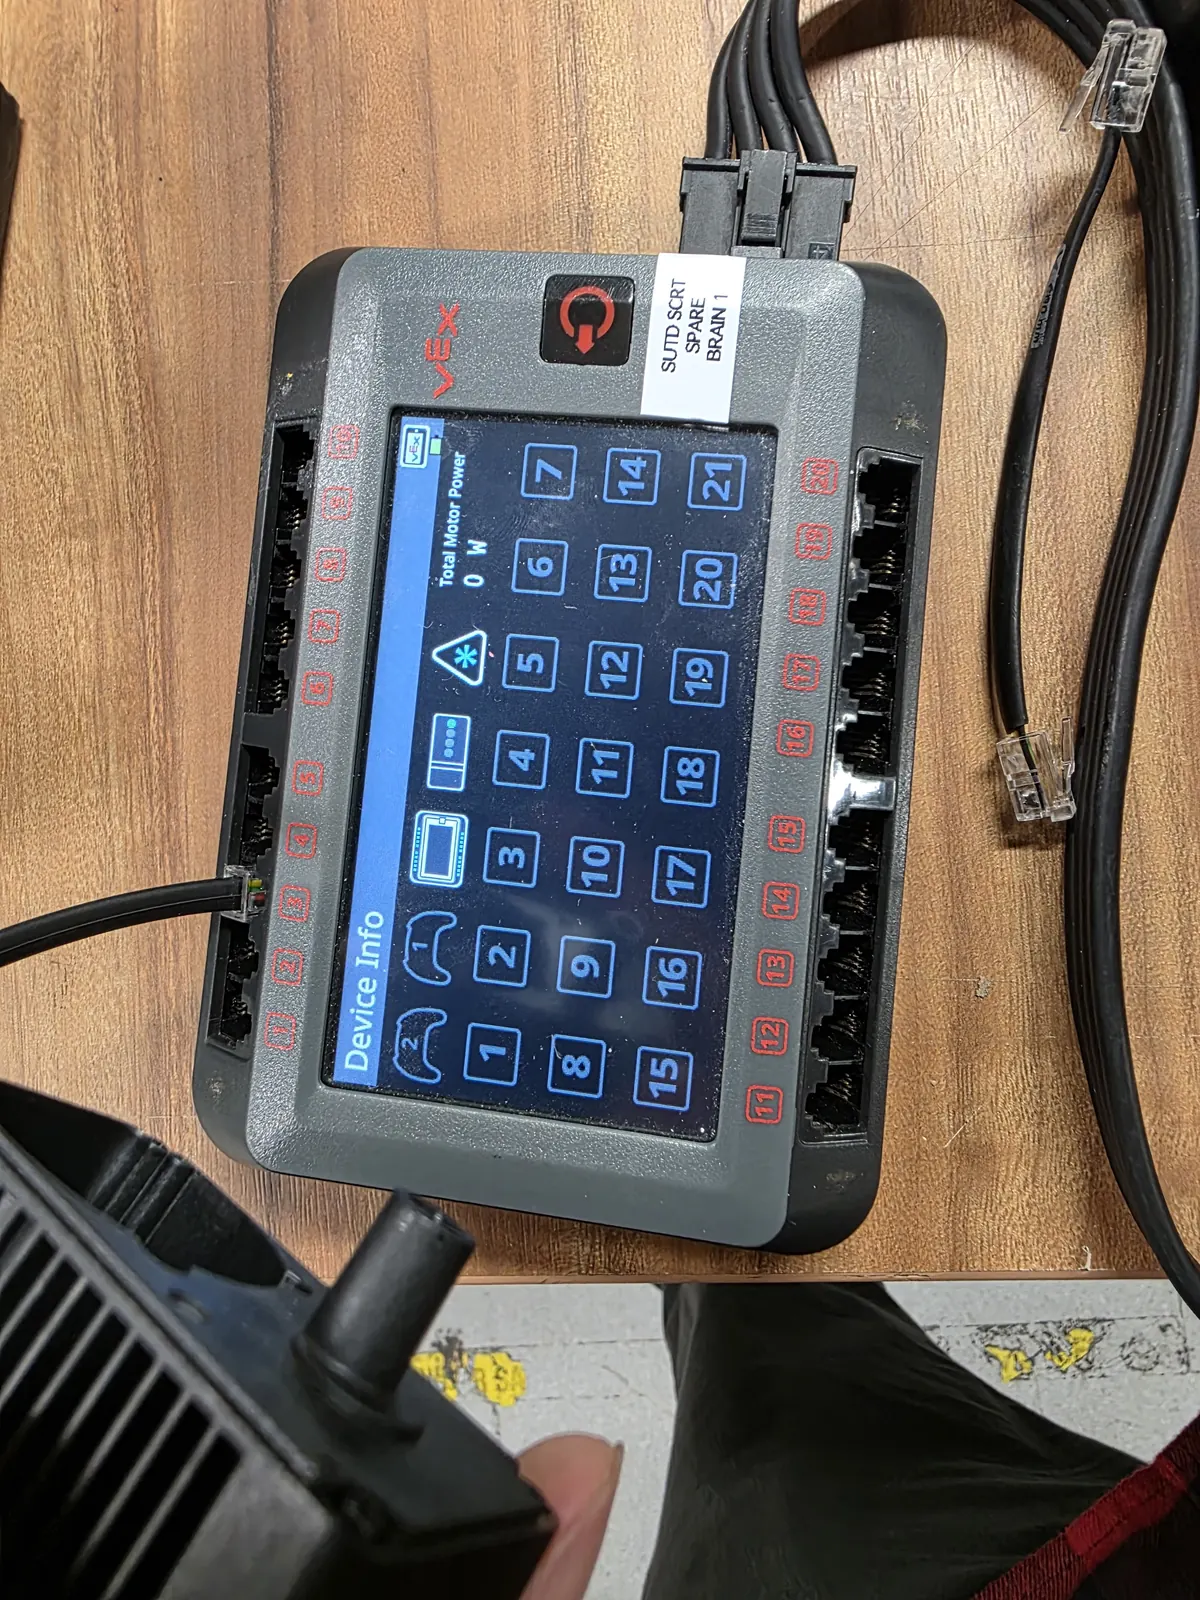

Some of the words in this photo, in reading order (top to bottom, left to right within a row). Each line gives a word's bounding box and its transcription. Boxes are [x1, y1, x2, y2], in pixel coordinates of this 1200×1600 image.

[667, 279, 685, 320] SCRT
[686, 297, 706, 354] SPARE
[707, 308, 726, 361] BRAIN
[661, 325, 679, 372] SUTD
[448, 451, 465, 498] Power
[535, 459, 562, 482] 7
[618, 457, 646, 496] 14
[703, 462, 732, 501] 21
[811, 463, 830, 489] 20
[444, 502, 460, 547] Motor
[467, 540, 487, 555] W
[805, 528, 823, 554] 19
[439, 551, 455, 587] Total
[528, 557, 553, 577] 6
[609, 554, 637, 592] 13
[693, 558, 722, 601] 20
[463, 574, 484, 587] 0
[798, 594, 817, 620] 18
[517, 654, 544, 673] 5
[600, 652, 628, 689] 12
[792, 660, 810, 684] 17
[685, 658, 713, 696] 19
[786, 726, 805, 750] 16
[509, 749, 535, 771] 4
[592, 750, 619, 784] 11
[300, 772, 315, 784] 5
[676, 758, 704, 794] 18
[294, 835, 309, 846] 4
[778, 822, 796, 846] 15
[499, 847, 525, 868] 3
[581, 845, 609, 887] 10
[666, 856, 695, 895] 17
[287, 897, 302, 909] 3
[772, 888, 791, 913] 14
[356, 912, 384, 969] Info
[412, 942, 427, 951] 1
[280, 960, 295, 973] 2
[489, 946, 515, 968] 2
[571, 955, 599, 977] 9
[766, 956, 785, 980] 13
[658, 958, 687, 996] 16
[273, 1025, 289, 1036] 1
[345, 978, 377, 1071] Device
[761, 1023, 780, 1048] 12
[402, 1038, 418, 1050] 2
[479, 1043, 506, 1062] 1
[562, 1055, 590, 1078] 8
[649, 1059, 677, 1097] 15
[755, 1093, 774, 1116] 11
